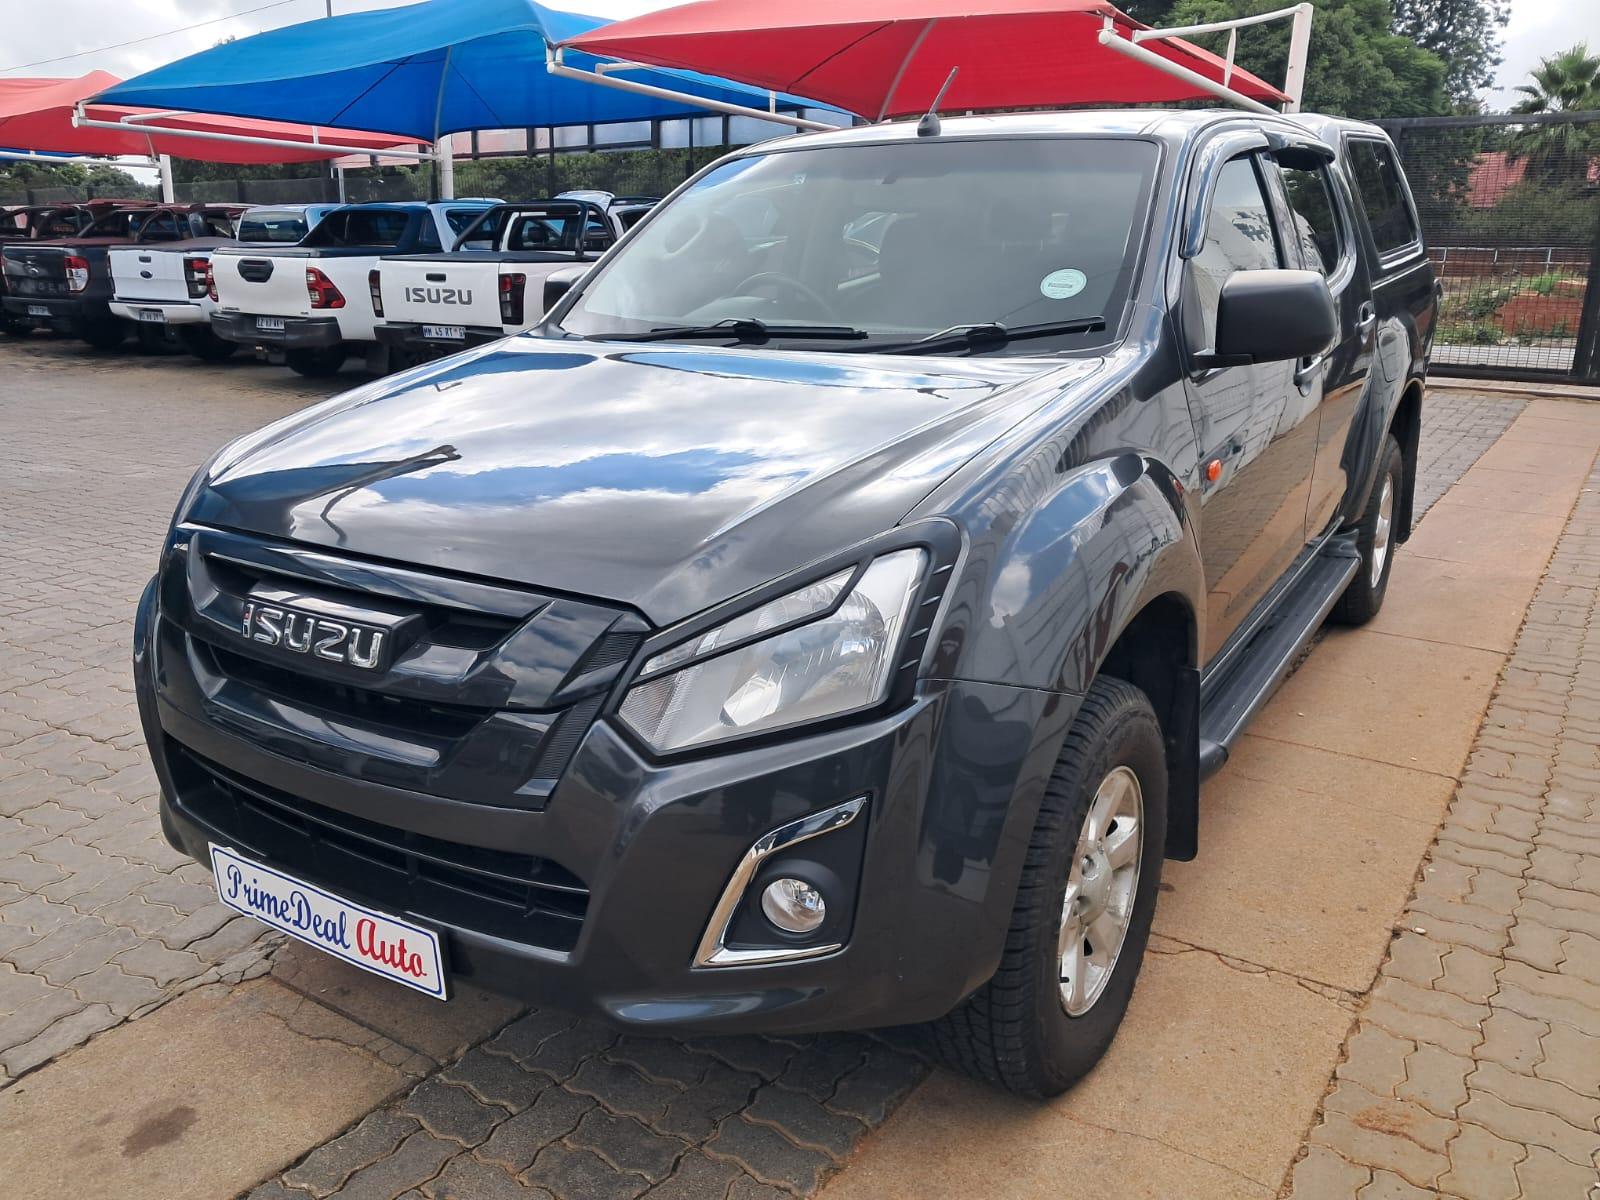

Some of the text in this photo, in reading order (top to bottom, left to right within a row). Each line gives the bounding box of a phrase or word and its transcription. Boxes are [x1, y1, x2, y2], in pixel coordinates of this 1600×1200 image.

[405, 287, 473, 306] ISUZU
[242, 603, 384, 669] ISUZU
[226, 864, 428, 978] PrimeDeal Auto
